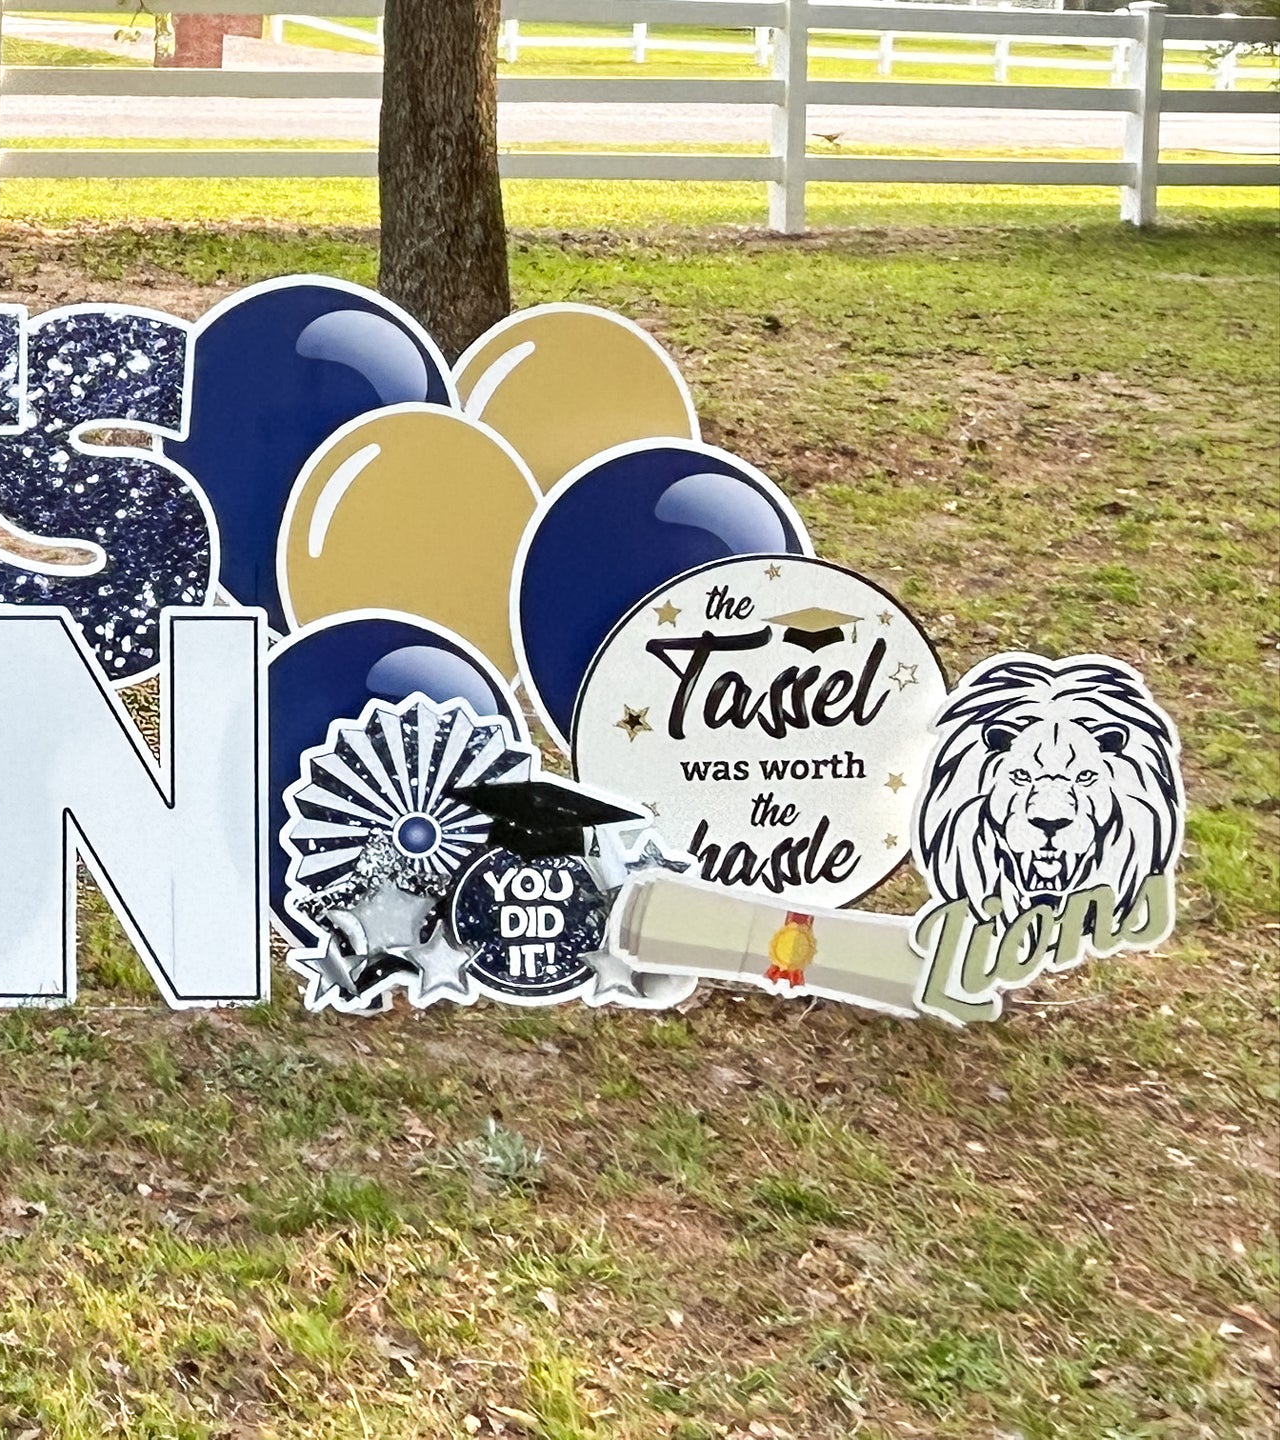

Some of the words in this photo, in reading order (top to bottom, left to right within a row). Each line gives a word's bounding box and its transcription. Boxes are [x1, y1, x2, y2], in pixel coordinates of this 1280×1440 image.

[705, 585, 755, 621] the
[646, 625, 891, 740] Tassel
[680, 759, 750, 782] was
[759, 750, 867, 782] worth
[750, 792, 800, 828] the
[687, 815, 863, 894] hassle
[483, 866, 574, 903] YOU
[499, 905, 565, 939] DID
[505, 943, 558, 977] IT!
[915, 873, 1169, 1022] Lions
